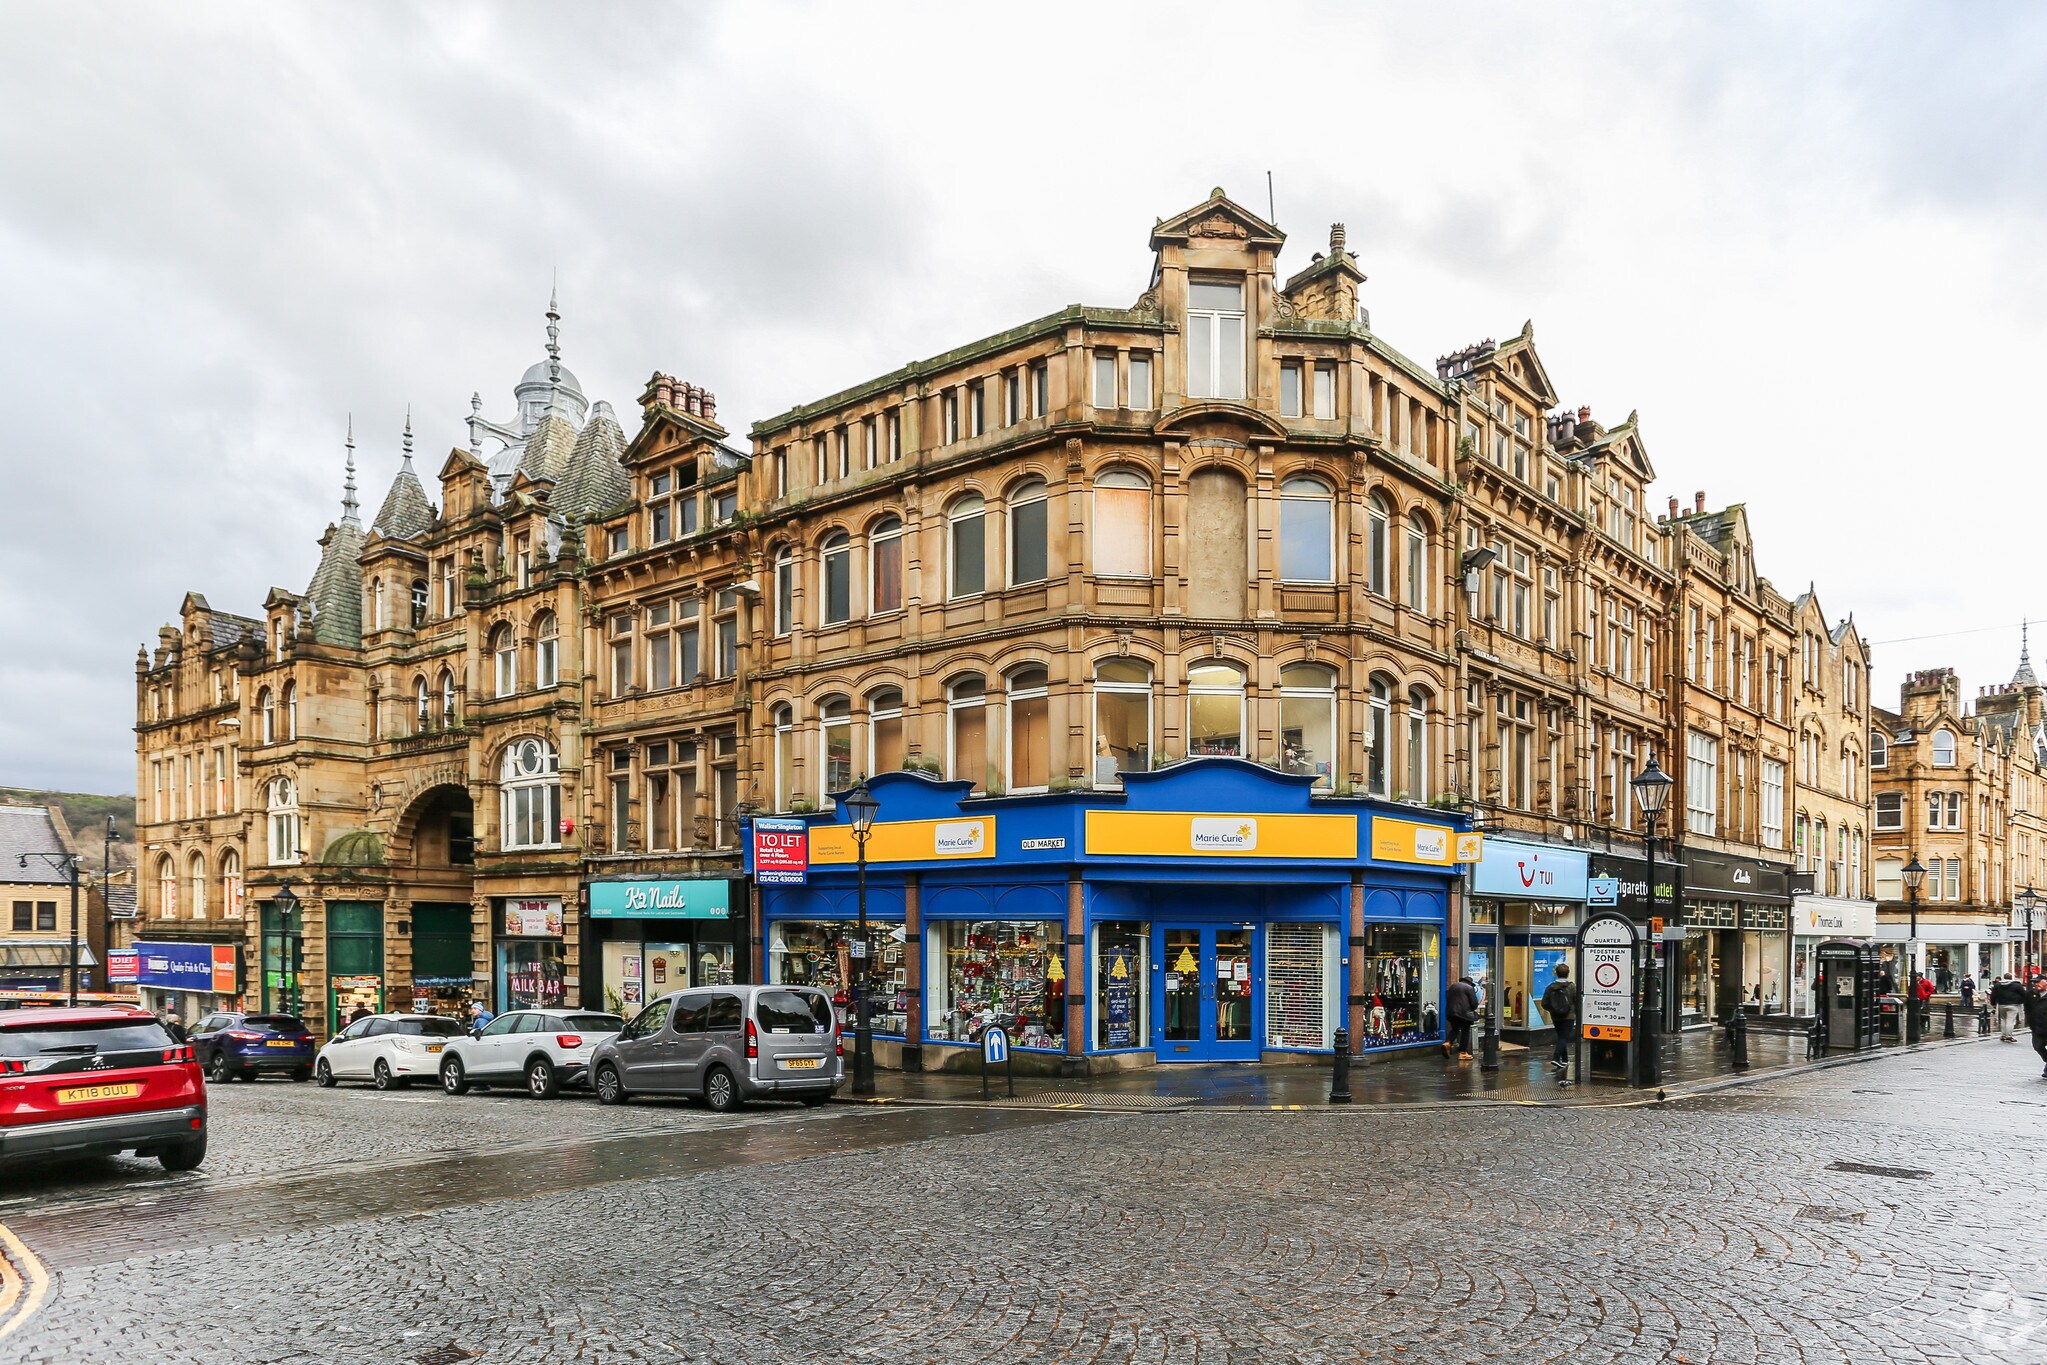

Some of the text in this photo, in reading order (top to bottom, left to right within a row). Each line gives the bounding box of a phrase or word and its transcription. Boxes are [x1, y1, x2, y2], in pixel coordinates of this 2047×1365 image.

[758, 823, 803, 831] WalkerSingleton
[759, 834, 802, 847] TO LET
[938, 837, 973, 847] Marie Curie
[1195, 833, 1243, 843] Marie Curie
[1022, 839, 1064, 849] OLD MARKET
[1417, 843, 1440, 853] Marie Curie
[1539, 871, 1553, 885] TUI
[1654, 883, 1673, 898] utlet
[648, 885, 685, 909] Nails
[1591, 921, 1624, 932] MARKET
[1817, 914, 1843, 928] Thomas Cook
[1594, 954, 1621, 962] ZONE
[527, 962, 541, 972] THE
[511, 978, 560, 994] MILK BAR
[68, 1085, 129, 1100] KT18 OUU
